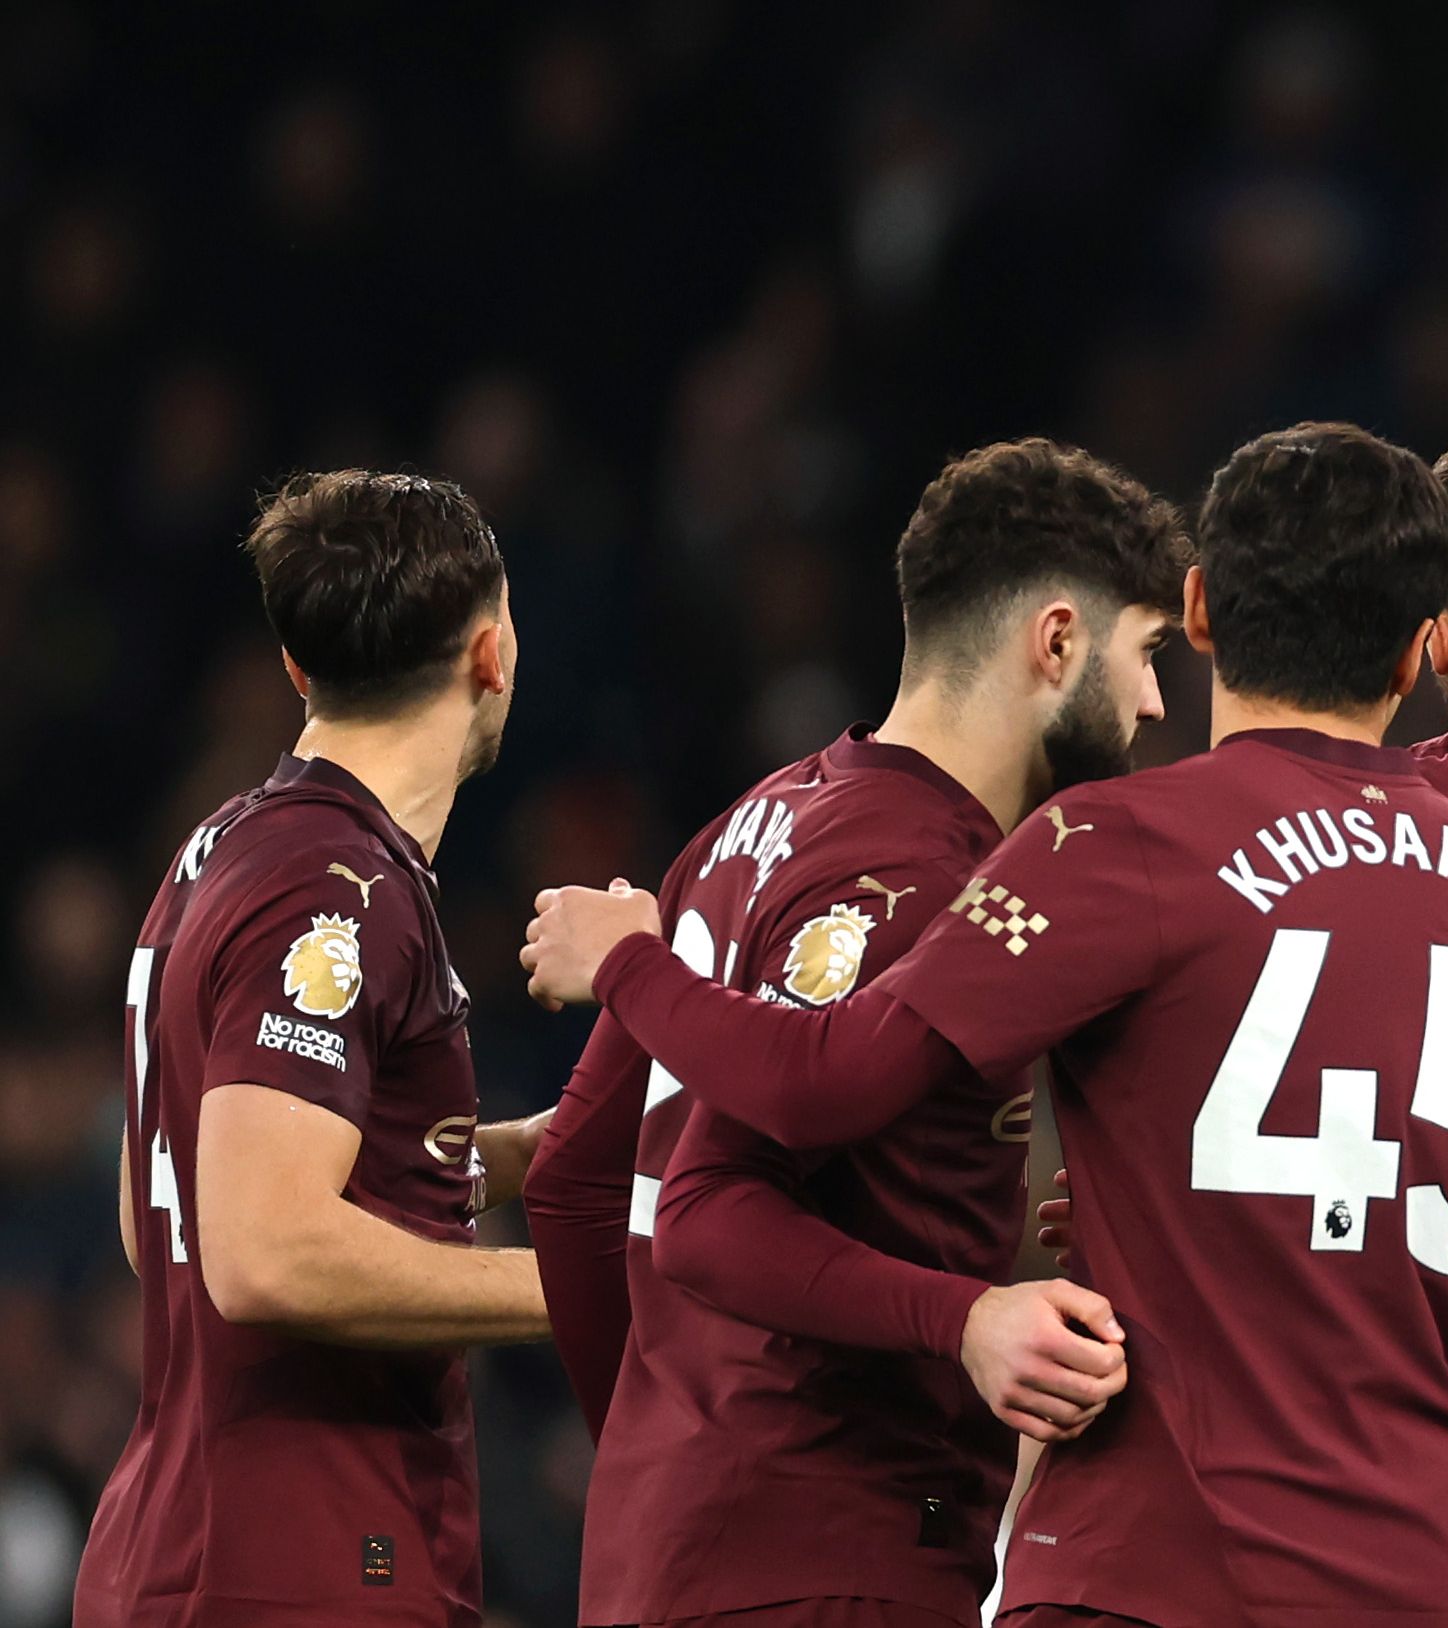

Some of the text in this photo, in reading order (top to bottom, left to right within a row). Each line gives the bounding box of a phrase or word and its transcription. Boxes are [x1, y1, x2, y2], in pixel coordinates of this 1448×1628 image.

[256, 1029, 346, 1072] for racism
[260, 1012, 344, 1053] No room
